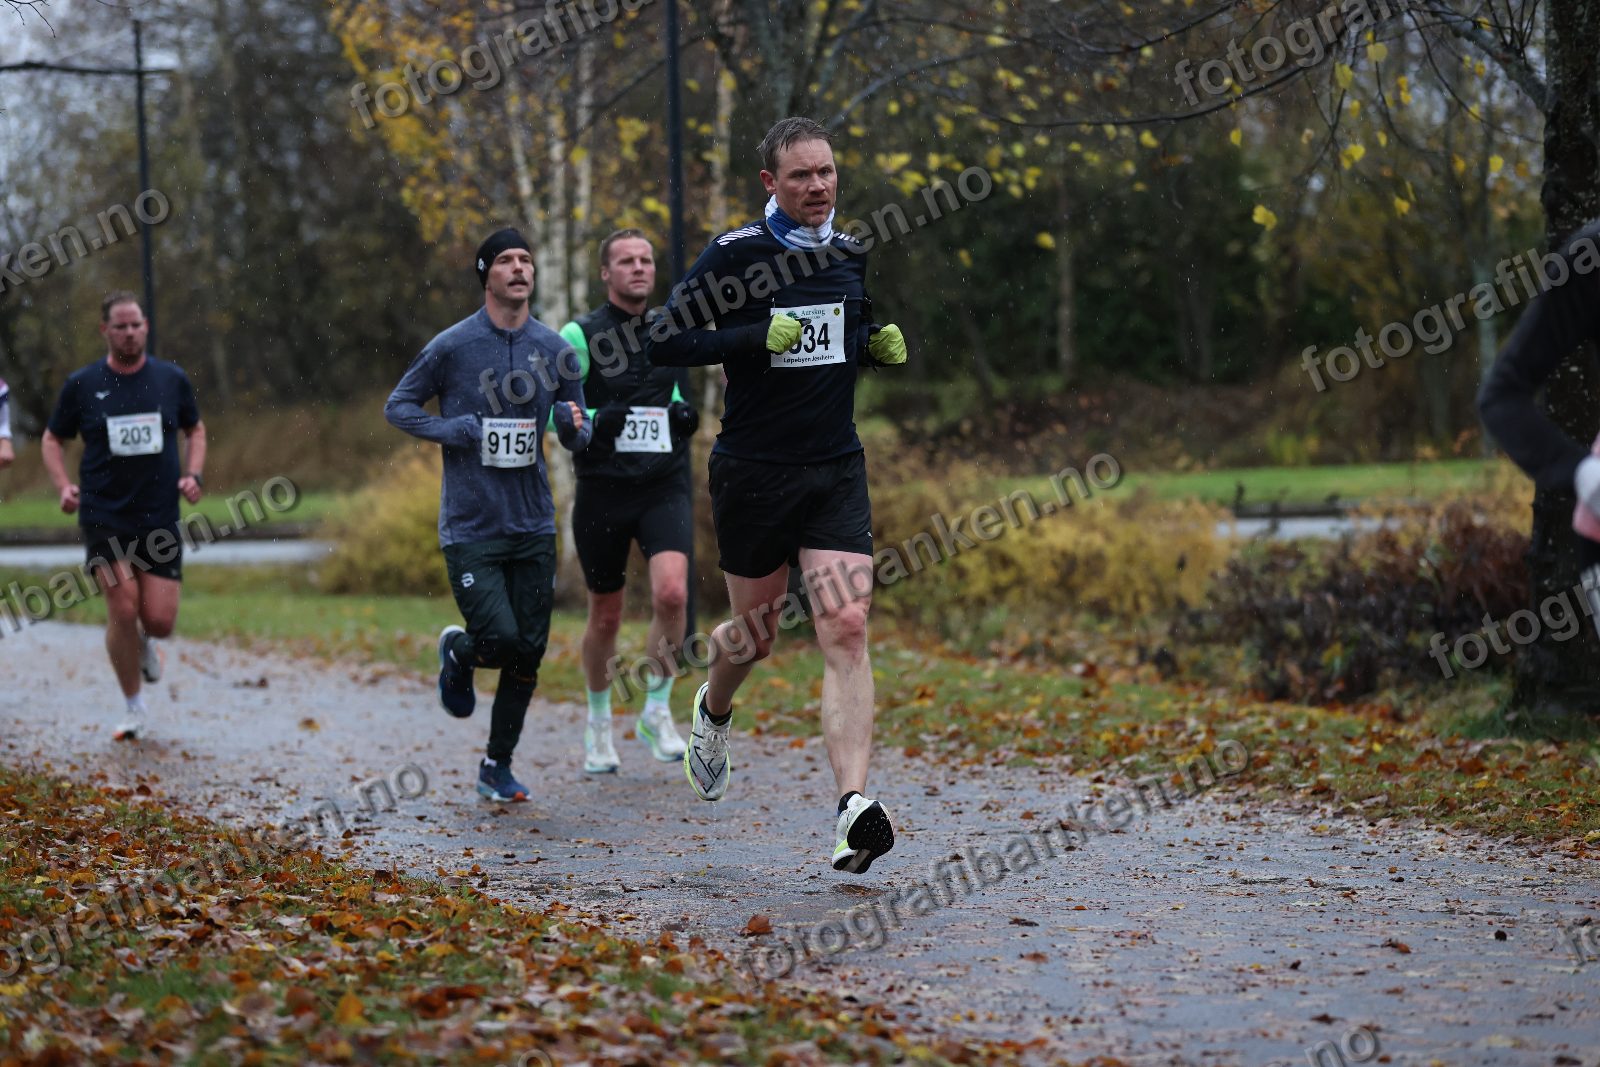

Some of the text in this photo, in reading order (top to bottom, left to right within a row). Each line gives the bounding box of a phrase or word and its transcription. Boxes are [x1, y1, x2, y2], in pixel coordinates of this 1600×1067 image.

[120, 425, 152, 446] 203
[626, 420, 659, 441] 379
[487, 431, 535, 455] 9152
